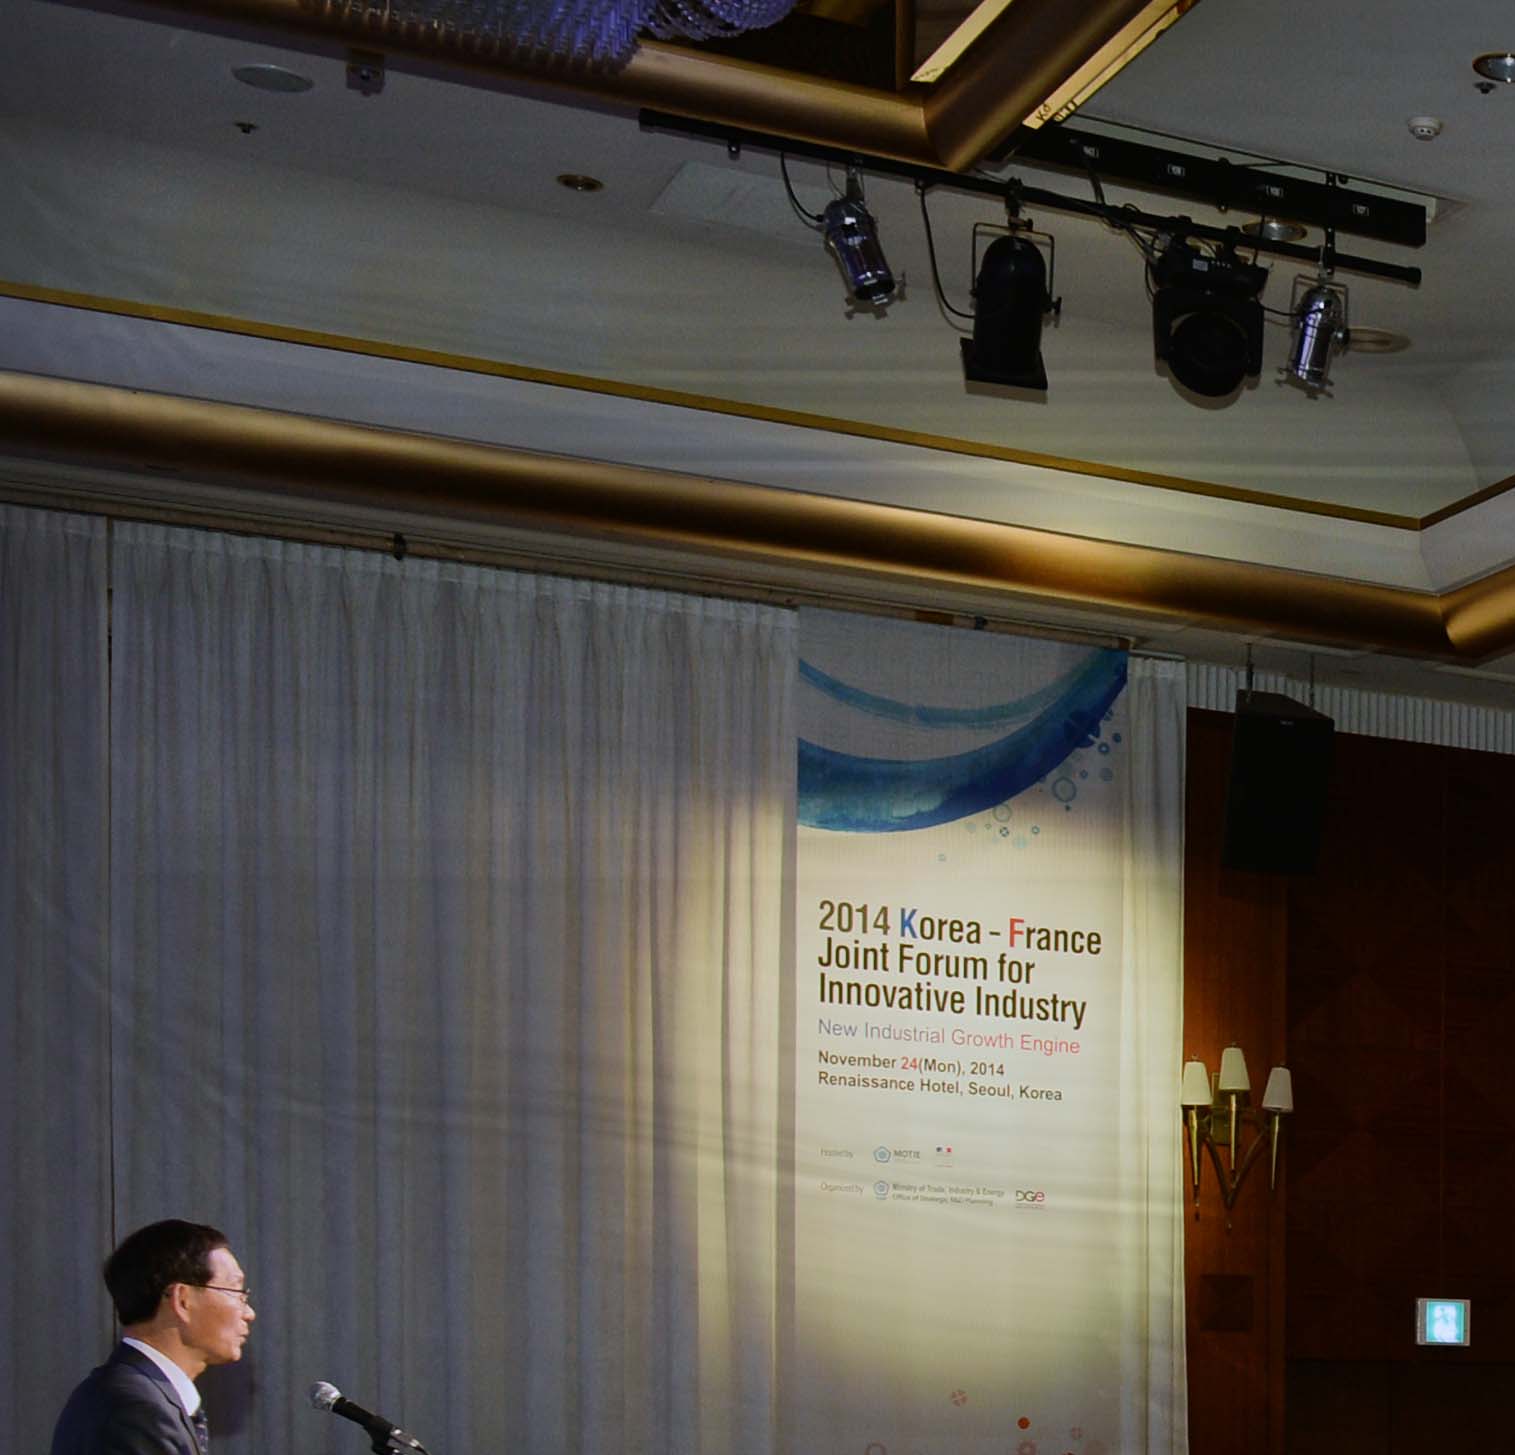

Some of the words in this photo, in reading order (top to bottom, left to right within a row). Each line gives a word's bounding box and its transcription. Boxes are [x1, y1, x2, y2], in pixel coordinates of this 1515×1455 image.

[818, 900, 891, 936] 2014
[900, 907, 981, 944] Korea
[1009, 917, 1102, 955] France
[818, 937, 889, 972] Joint
[899, 944, 988, 981] Forum
[998, 953, 1036, 984] for
[819, 973, 966, 1014] Innovative
[976, 986, 1087, 1030] Industry
[818, 1019, 858, 1038] New
[865, 1022, 945, 1044] Industrial
[952, 1029, 1014, 1049] Growth
[1020, 1034, 1080, 1056] Engine
[818, 1051, 896, 1069] November
[970, 1062, 1005, 1076] 2014
[818, 1072, 915, 1091] Renaissance
[920, 1077, 963, 1096] Hotel,
[968, 1082, 1014, 1099] Seoul,
[1019, 1086, 1063, 1101] Korea
